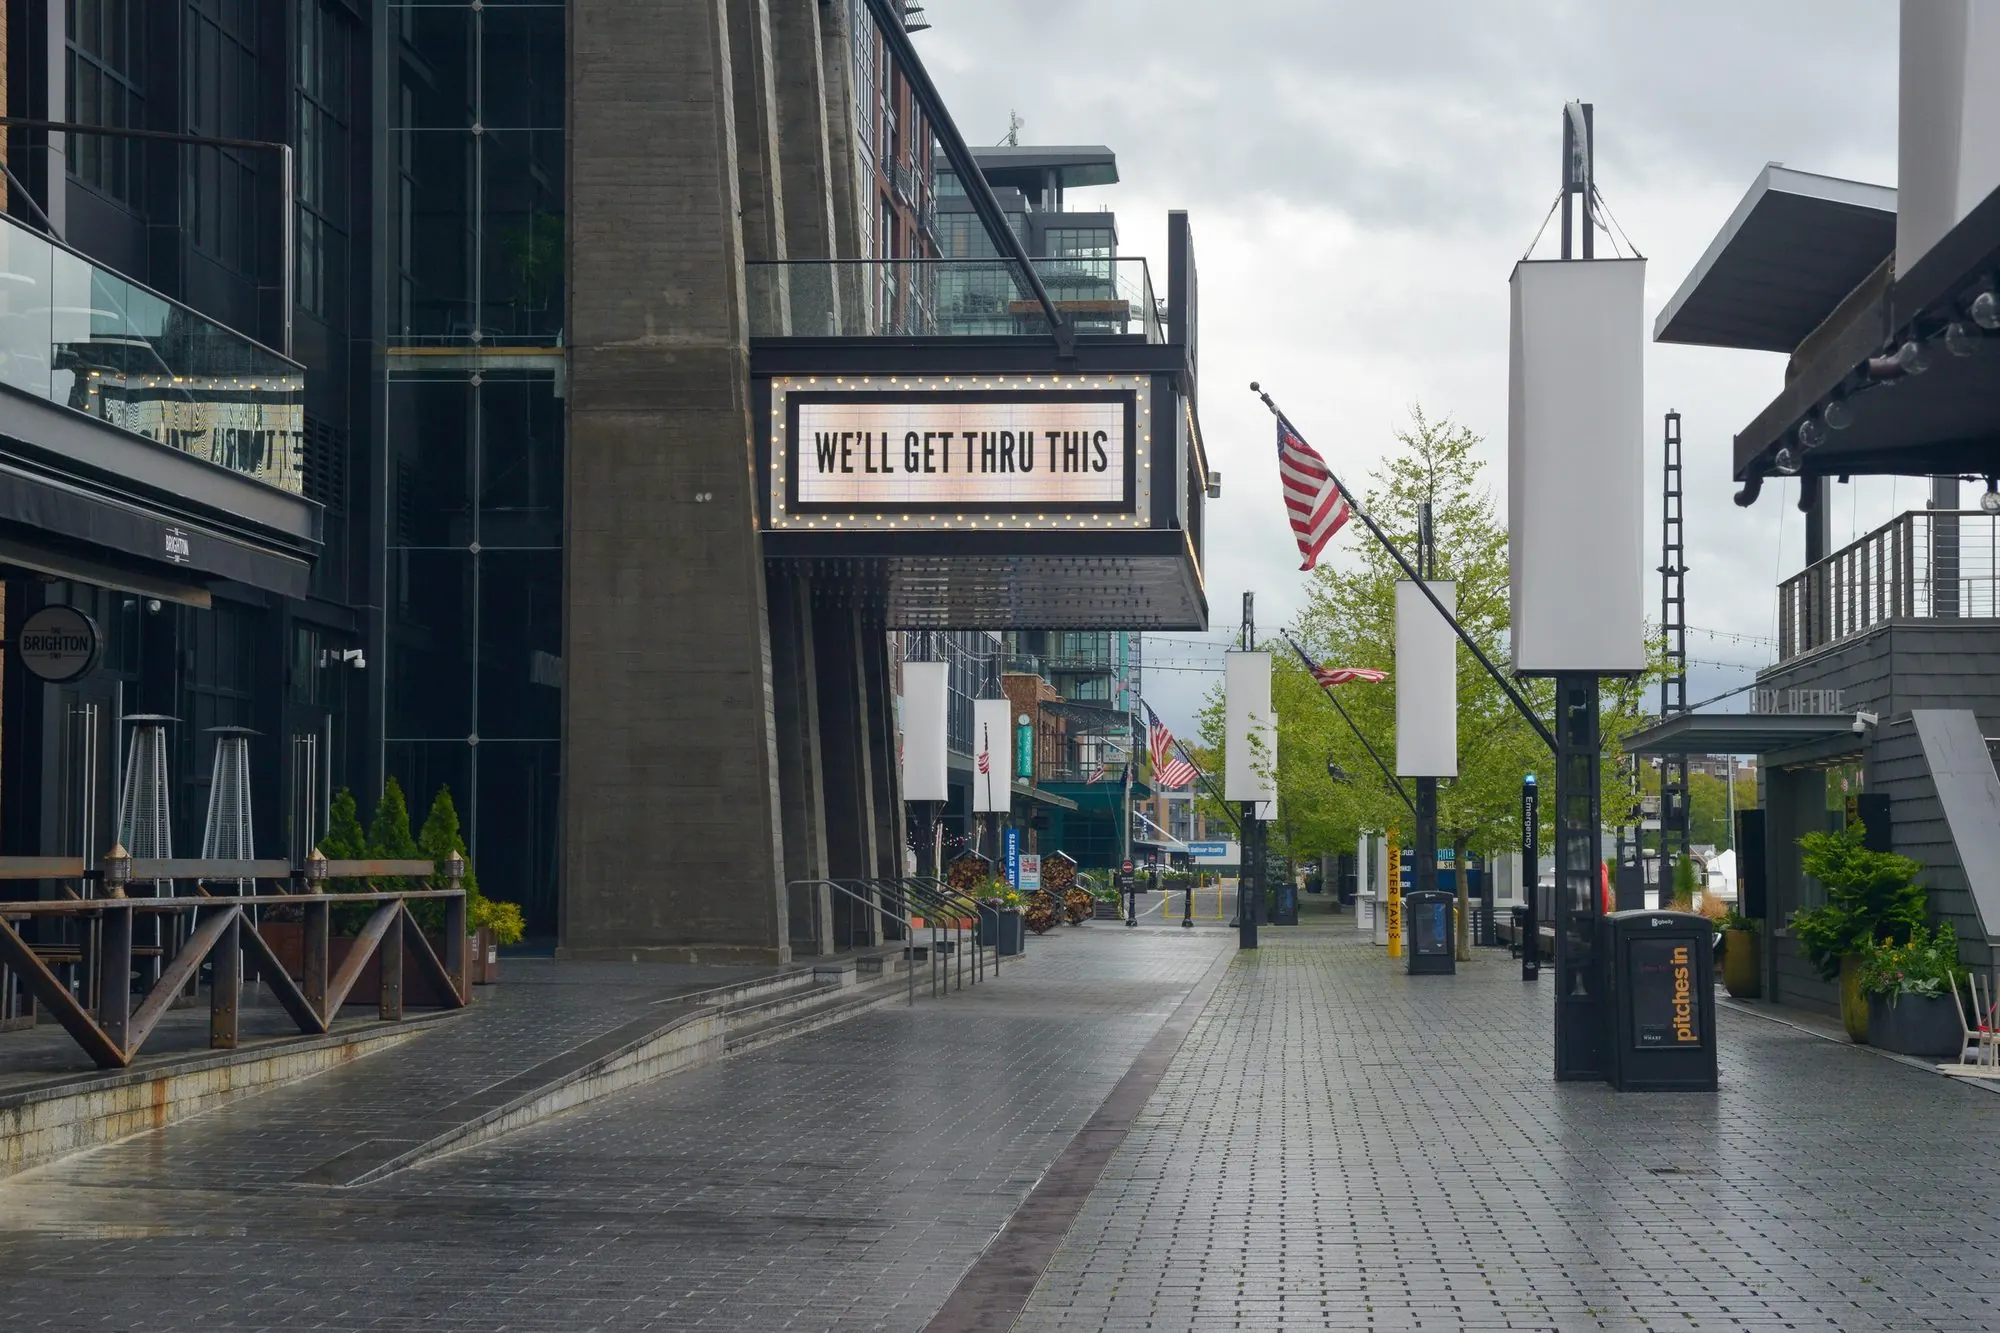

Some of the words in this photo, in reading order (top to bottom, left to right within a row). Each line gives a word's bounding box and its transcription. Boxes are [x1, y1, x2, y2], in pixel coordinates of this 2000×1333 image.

[815, 431, 894, 474] WE'LL
[904, 431, 954, 474] GET
[962, 430, 1034, 473] THRU
[1045, 430, 1108, 473] THIS
[165, 534, 189, 556] BRIGHTON
[23, 635, 89, 652] BRIGHTON
[1788, 689, 1846, 715] OFFICE
[1524, 796, 1534, 849] Emergency
[1008, 833, 1016, 867] EVENTS
[1389, 850, 1398, 895] WATER
[1389, 901, 1398, 930] TAXI
[1670, 947, 1688, 965] in
[1671, 966, 1697, 1041] pitches
